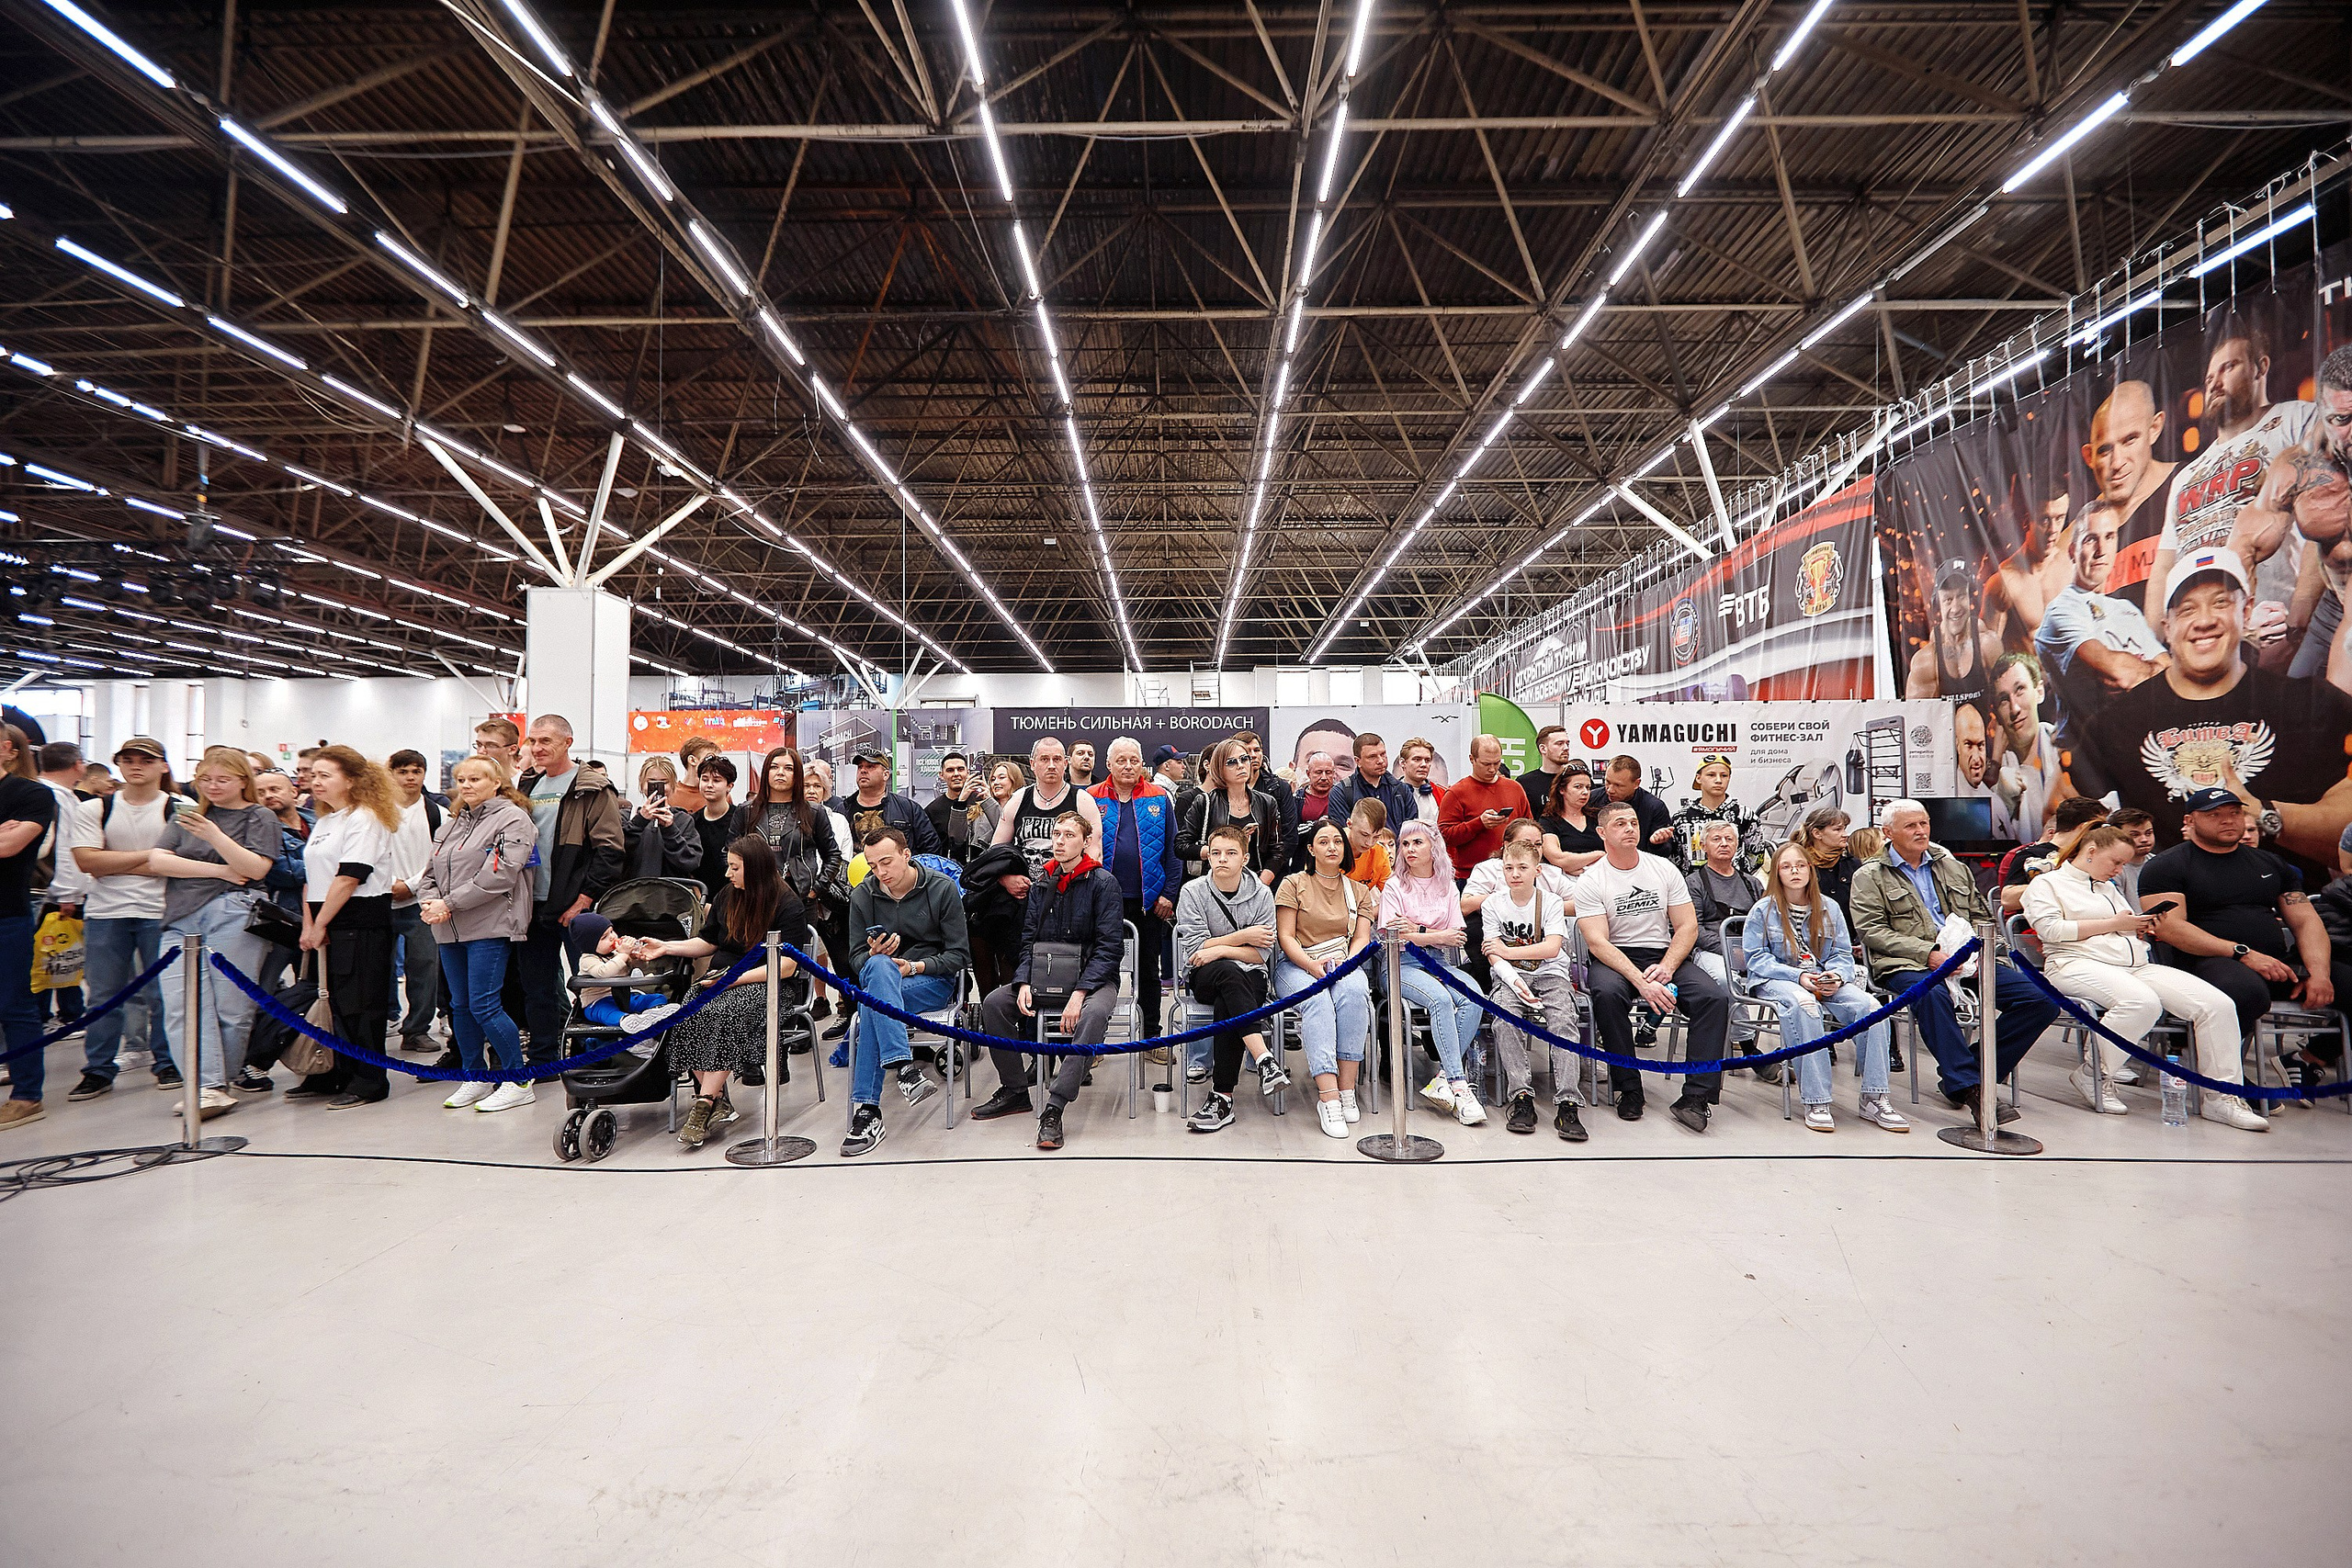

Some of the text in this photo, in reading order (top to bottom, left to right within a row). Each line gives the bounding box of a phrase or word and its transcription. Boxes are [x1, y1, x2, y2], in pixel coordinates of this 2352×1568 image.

[1736, 584, 1770, 628] ВТБ
[1011, 716, 1077, 730] ТЮМЕНЬ
[1080, 716, 1151, 730] СИЛЬНАЯ
[1170, 716, 1254, 730] BORODACH
[1750, 719, 1830, 731] СОБЕРИ СВОЙ
[1617, 723, 1736, 743] YAMAGUCHI
[1750, 733, 1824, 742] ФИТНЕС-ЗАЛ
[1022, 817, 1057, 840] СВО
[1616, 899, 1659, 911] DEMIX
